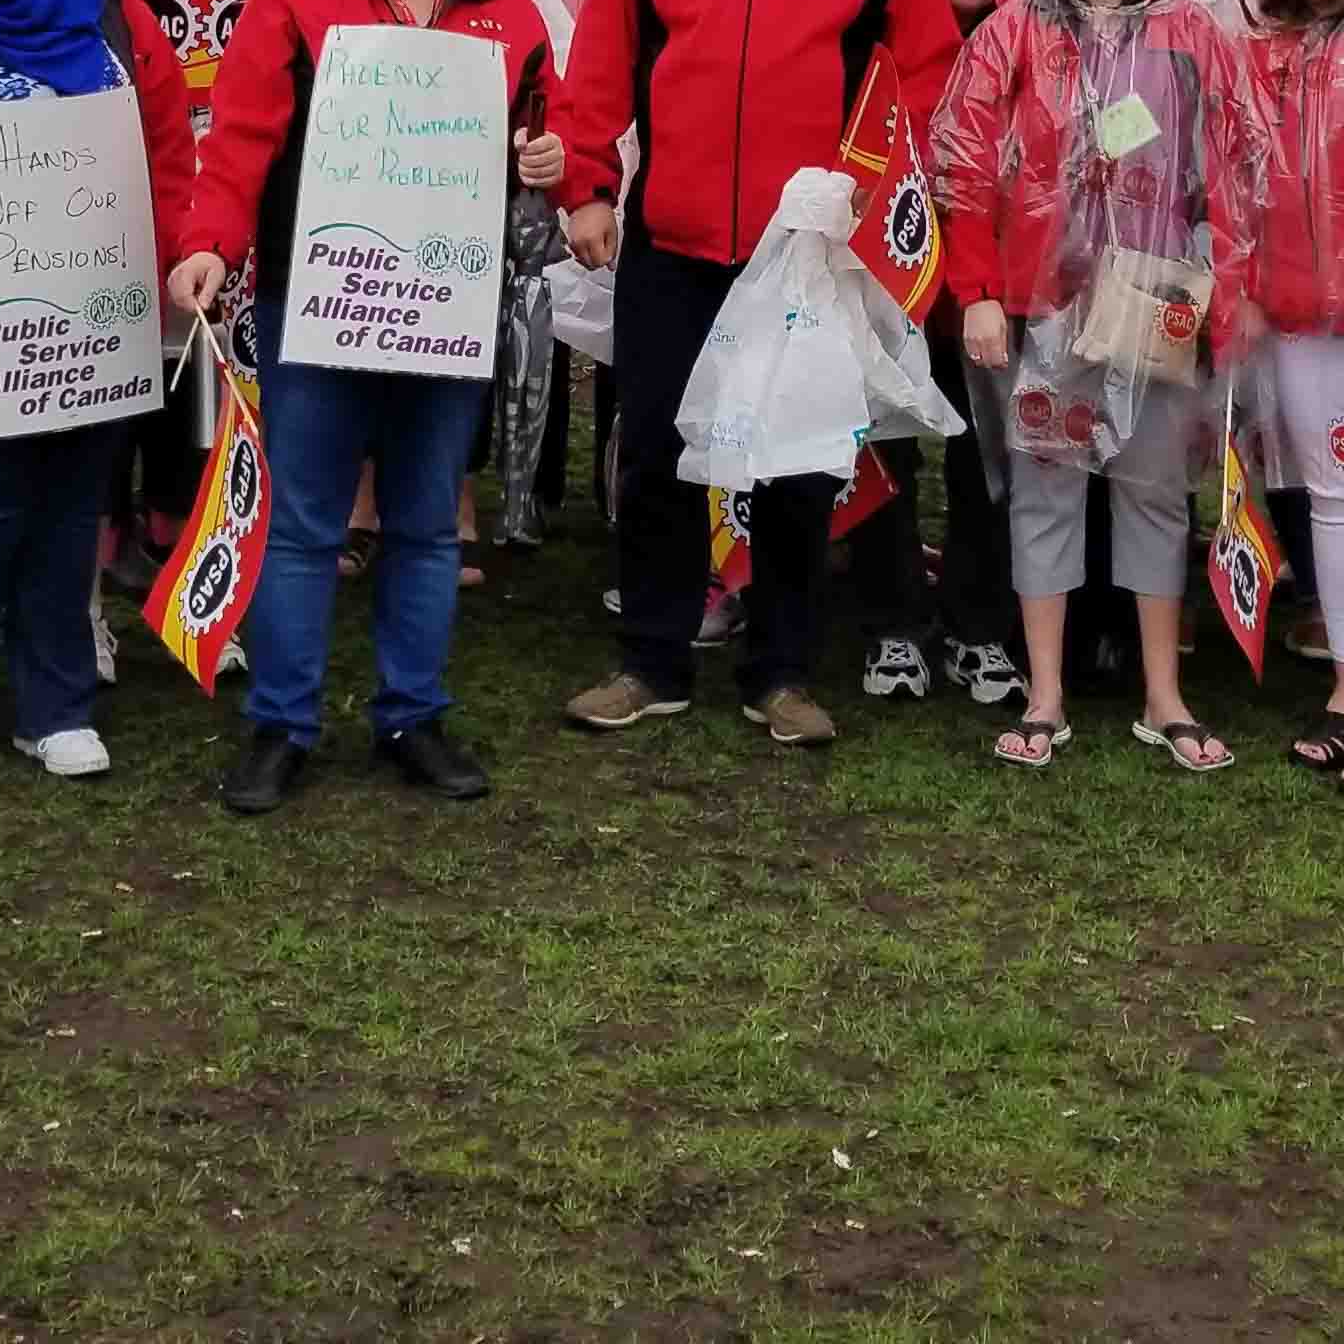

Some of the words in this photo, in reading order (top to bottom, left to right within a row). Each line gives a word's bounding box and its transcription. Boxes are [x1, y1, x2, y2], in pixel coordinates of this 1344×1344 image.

[160, 16, 185, 38] AC
[66, 186, 118, 217] OUR
[897, 194, 923, 251] PSAC
[307, 242, 401, 272] Public
[342, 272, 453, 303] Service
[301, 295, 421, 326] Alliance
[18, 335, 121, 365] Service
[336, 326, 370, 348] of
[377, 328, 483, 358] Canada
[20, 391, 50, 416] of
[59, 376, 153, 410] Canada
[233, 443, 253, 514] AFPC
[192, 547, 230, 615] PSAC
